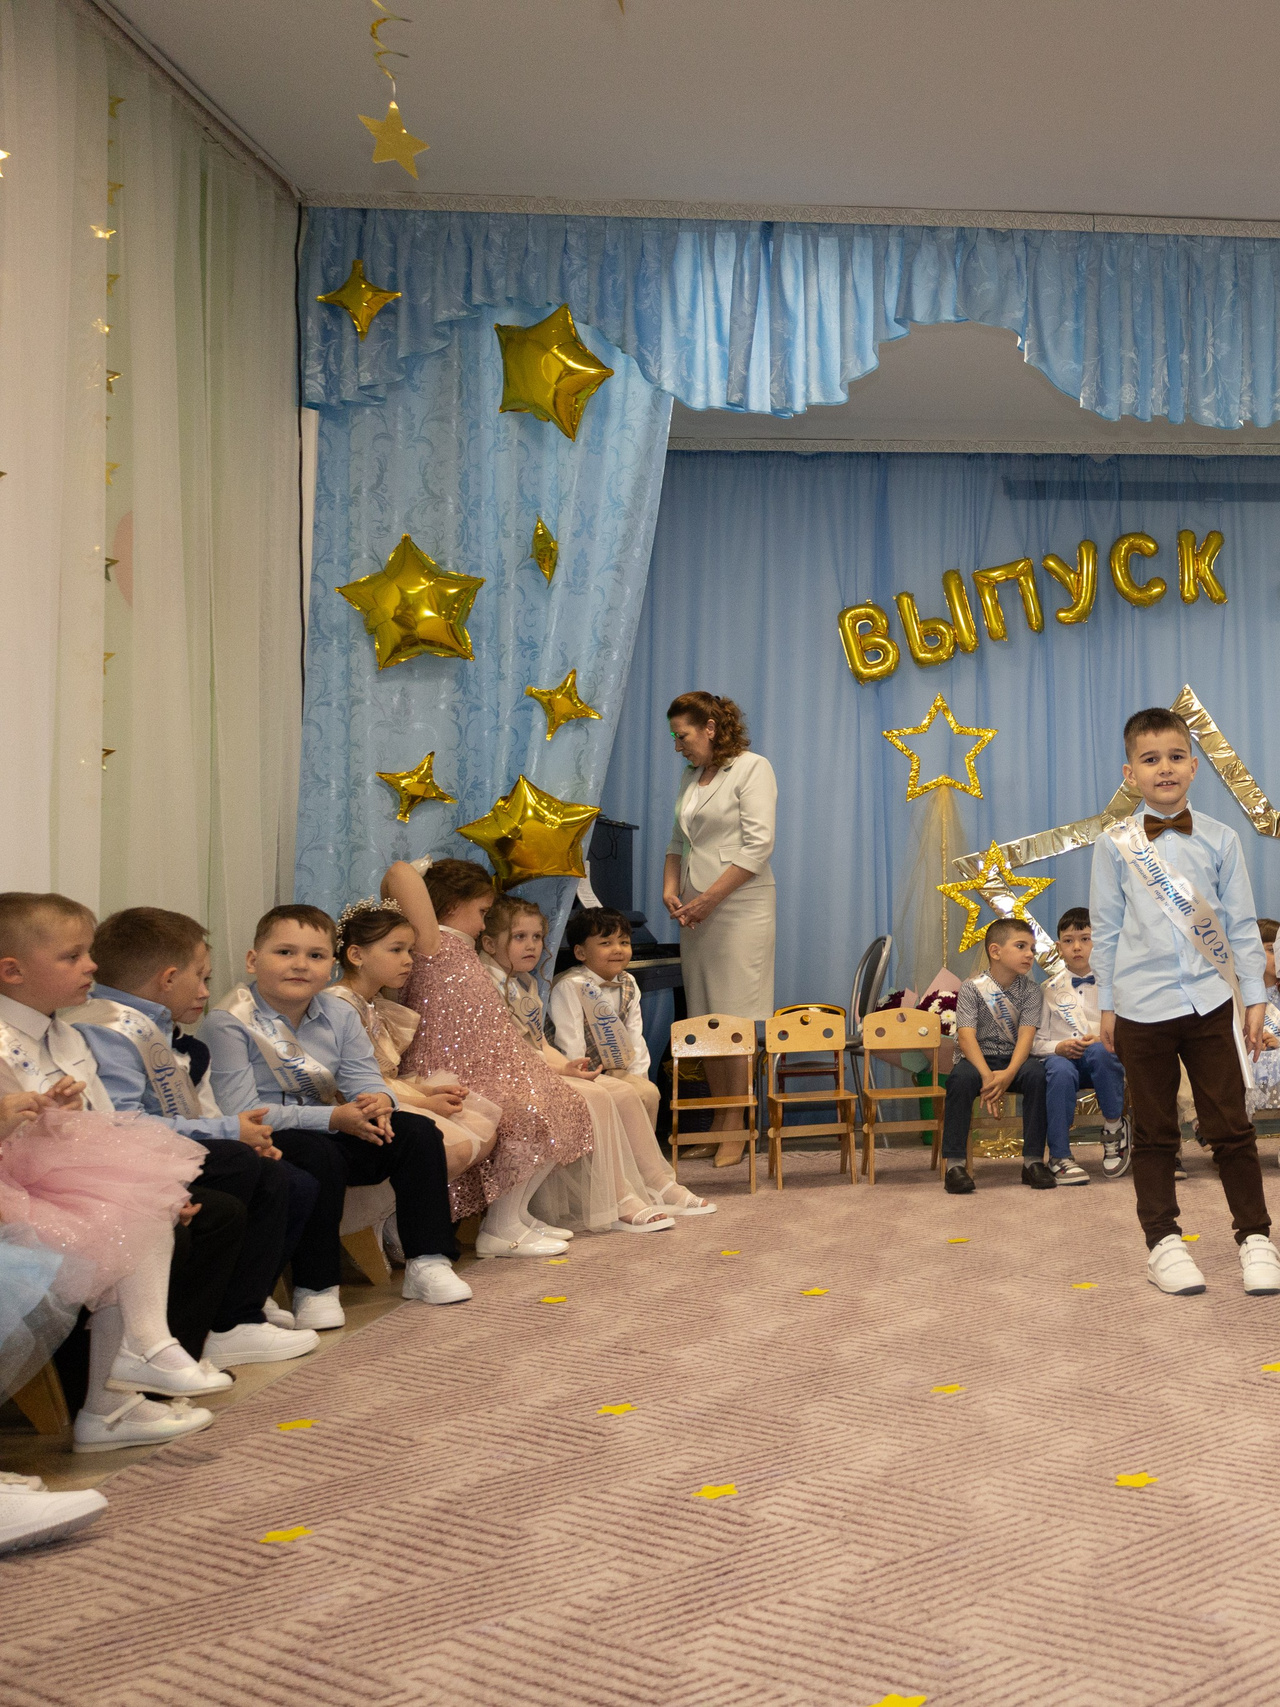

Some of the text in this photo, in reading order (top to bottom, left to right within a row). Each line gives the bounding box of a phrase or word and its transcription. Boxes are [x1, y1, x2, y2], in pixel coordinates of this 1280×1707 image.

[837, 528, 1228, 686] ВЫПУСК
[1127, 829, 1195, 917] Выпускник
[1190, 917, 1229, 965] 2025
